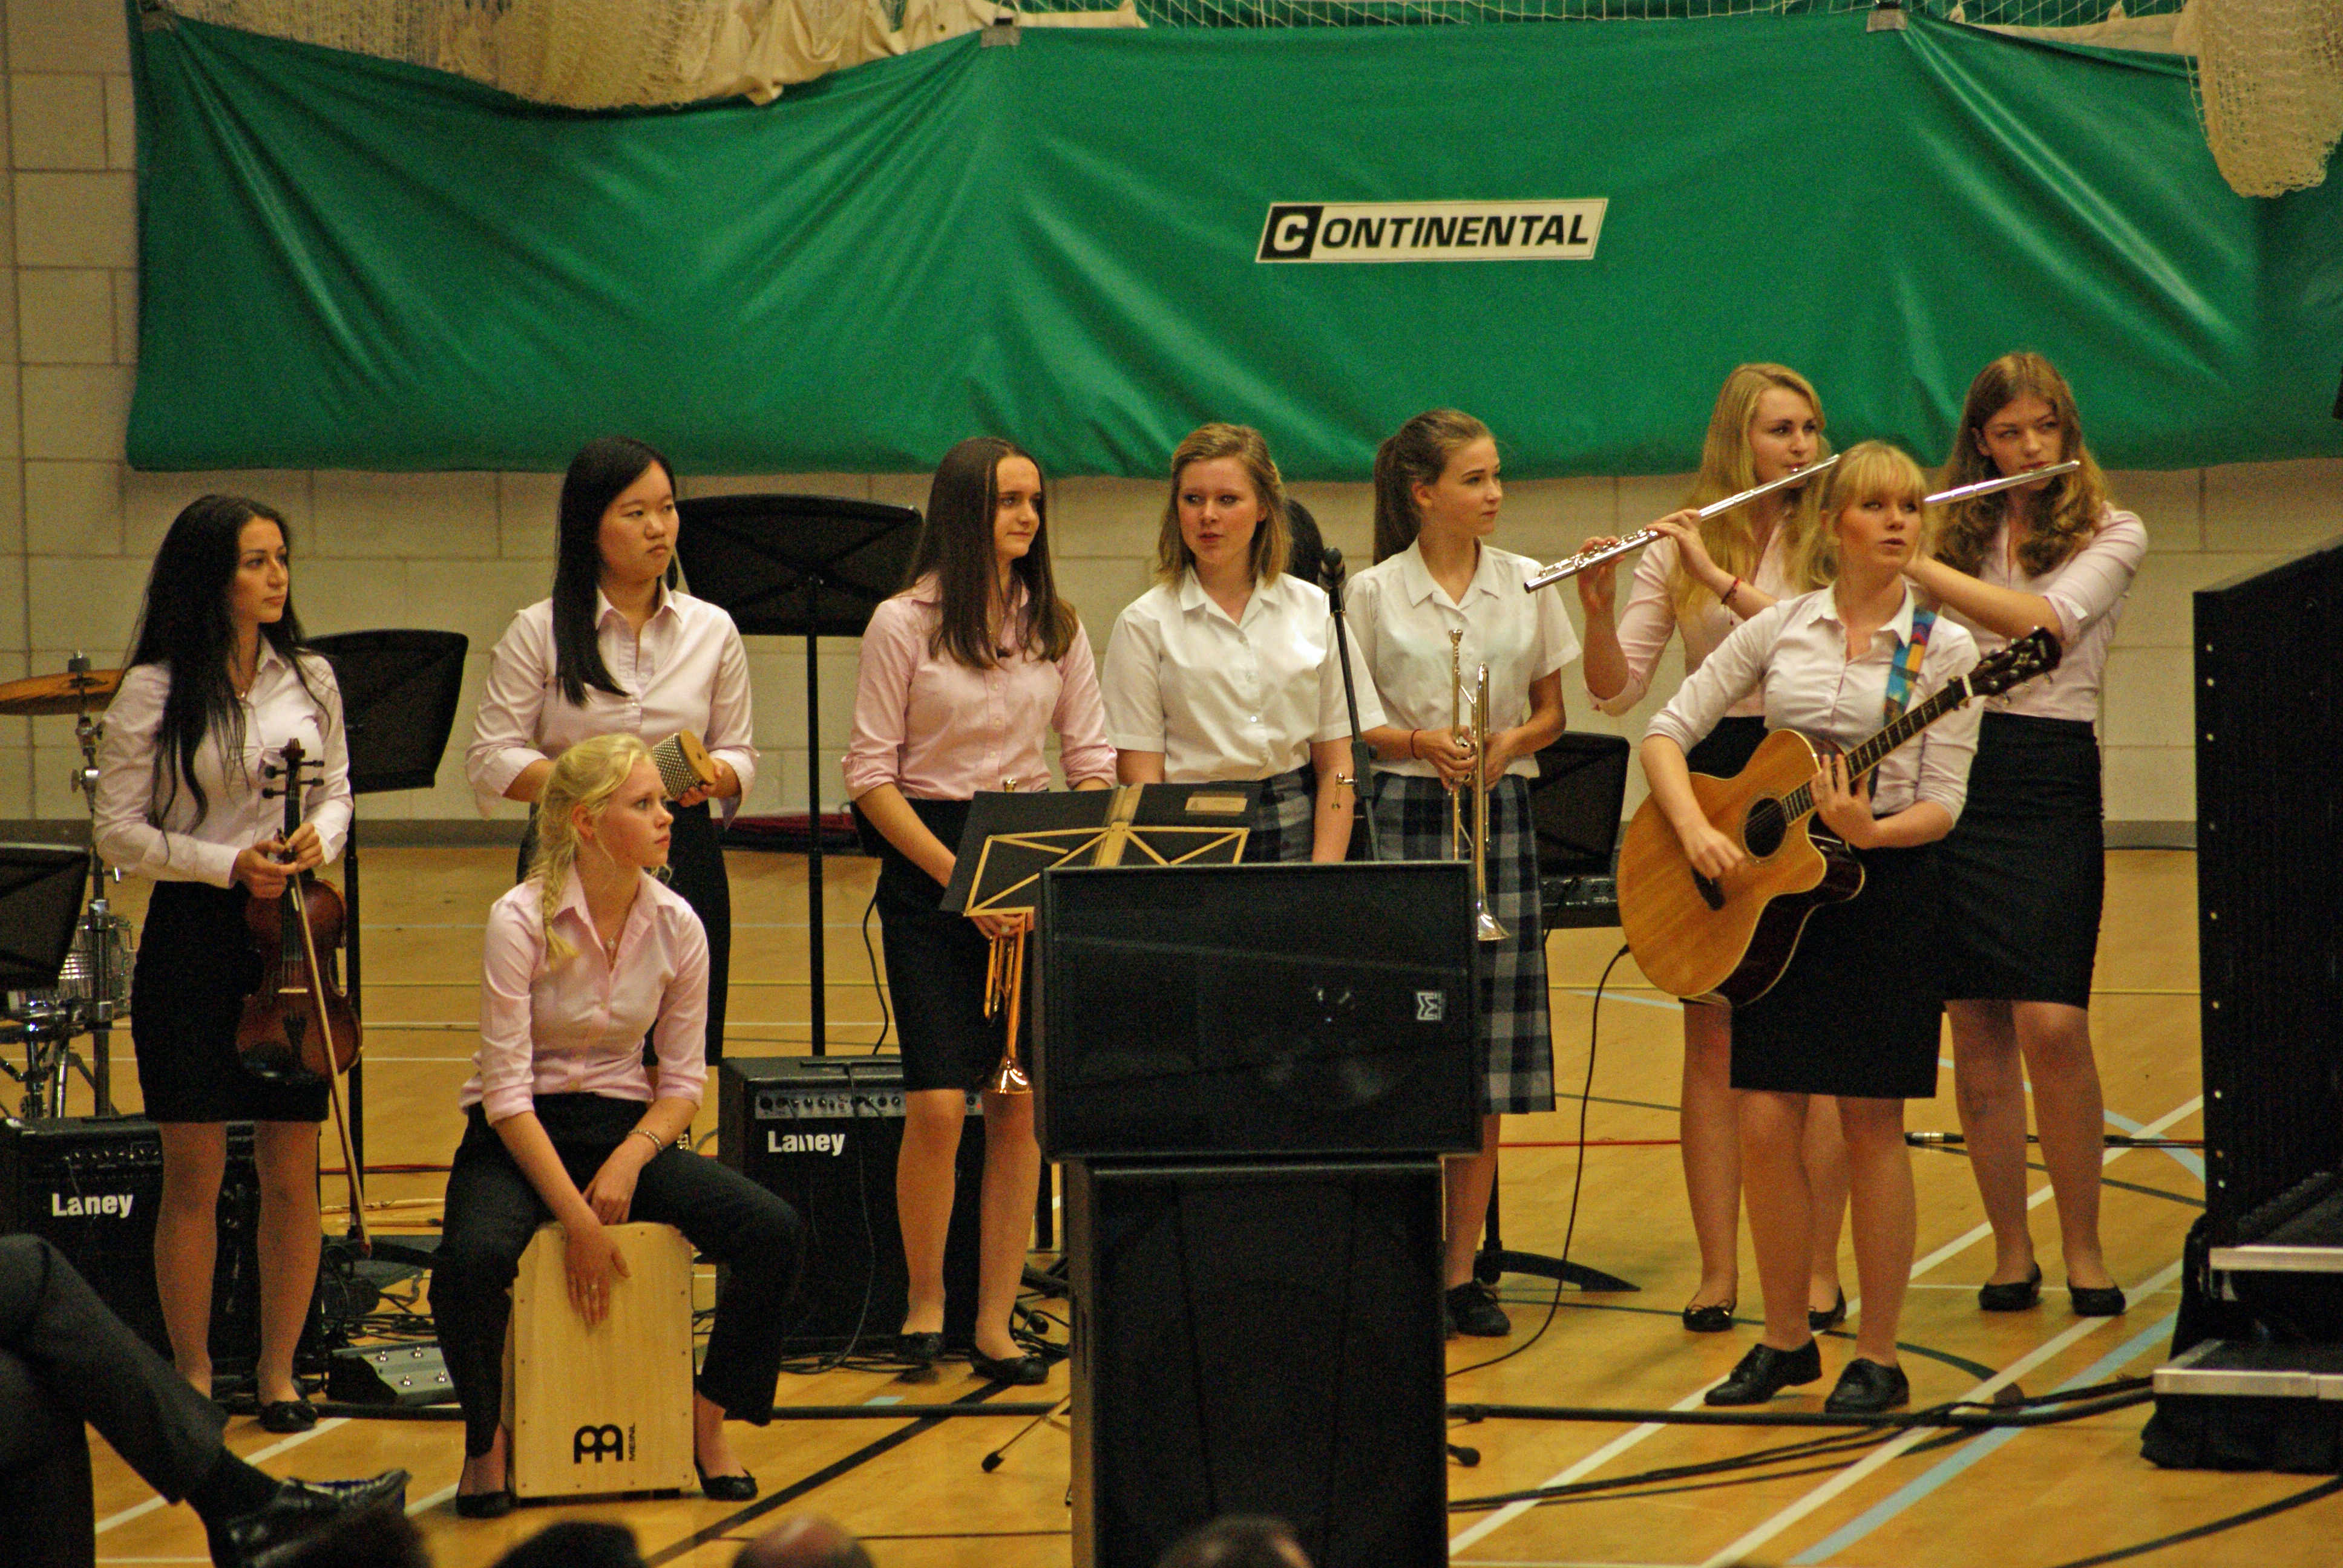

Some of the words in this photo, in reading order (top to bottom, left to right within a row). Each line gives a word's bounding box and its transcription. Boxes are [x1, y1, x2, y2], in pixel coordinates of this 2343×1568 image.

[1272, 214, 1589, 252] CONTINENTAL
[767, 1131, 845, 1157] Laney
[51, 1193, 133, 1218] Laney
